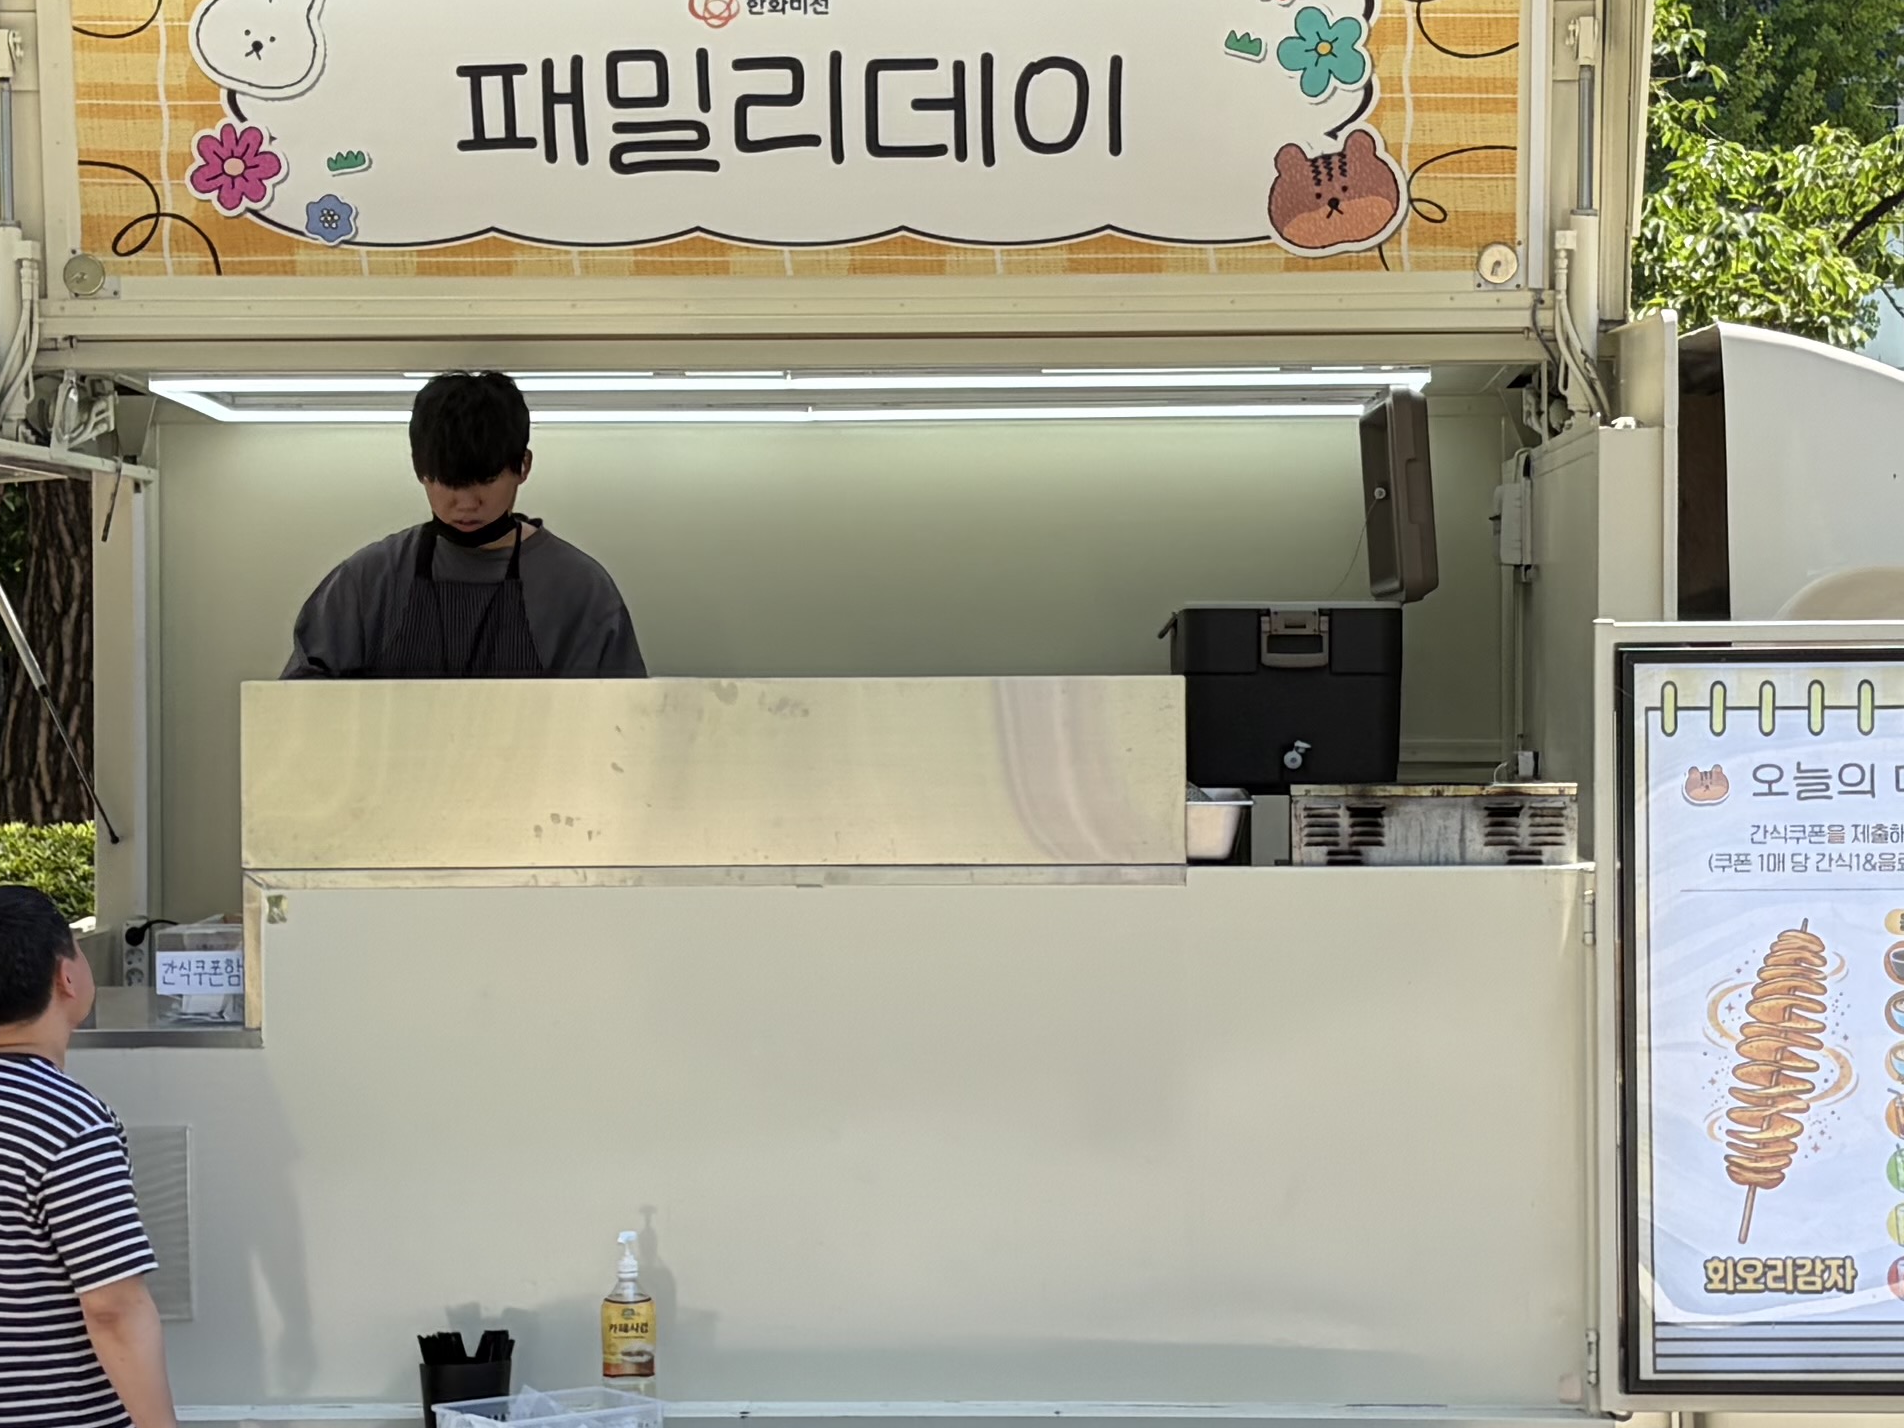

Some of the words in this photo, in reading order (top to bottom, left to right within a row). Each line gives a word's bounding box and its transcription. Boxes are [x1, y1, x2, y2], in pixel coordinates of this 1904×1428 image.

[456, 46, 1125, 175] 패밀리데이
[1751, 761, 1876, 800] 오늘의
[1750, 823, 1847, 846] 간식쿠폰을
[1708, 852, 1753, 874] (쿠폰
[1758, 853, 1787, 874] 1매
[1790, 853, 1811, 874] 당
[162, 958, 244, 987] 간식쿠폰함
[1704, 1256, 1858, 1296] 회오리감자
